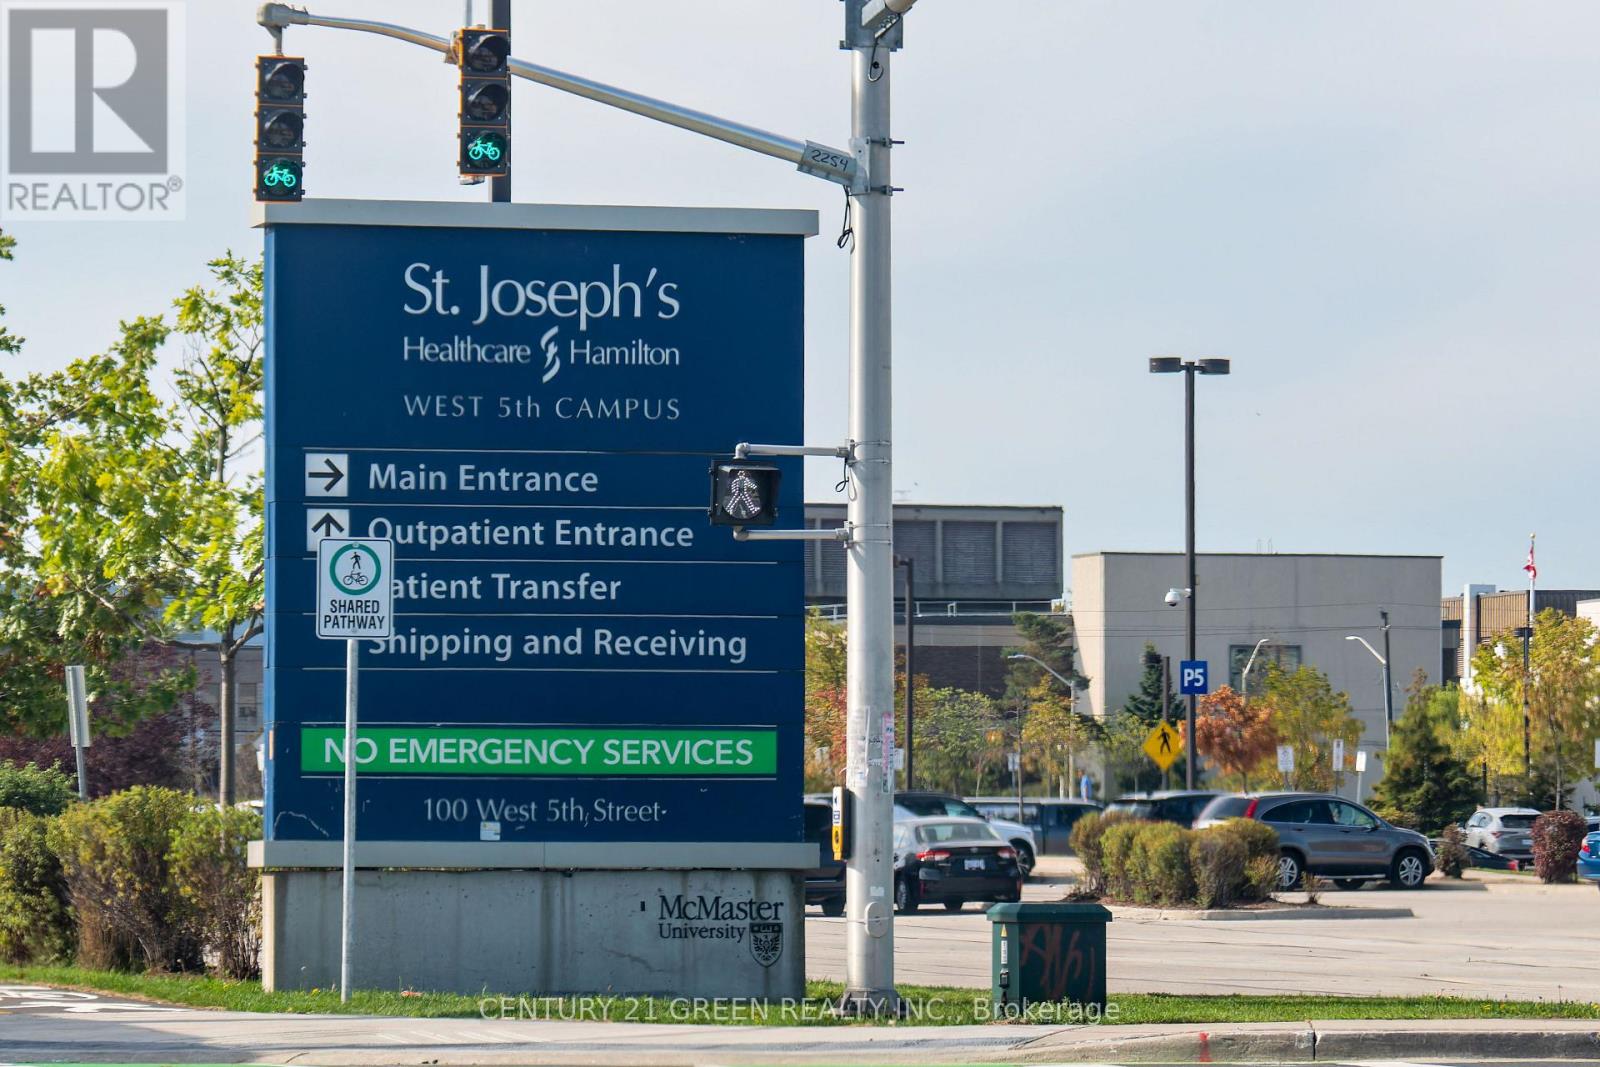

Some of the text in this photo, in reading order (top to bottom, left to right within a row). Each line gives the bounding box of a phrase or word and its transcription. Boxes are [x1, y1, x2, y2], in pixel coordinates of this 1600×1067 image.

[811, 149, 849, 172] 2254
[403, 262, 680, 331] St. Joseph's
[403, 336, 680, 366] Healthcare Hamilton
[404, 395, 680, 420] WEST 5th CAMPUS
[369, 463, 598, 492] Main Entrance
[368, 517, 694, 551] Outpatient Entrance
[393, 572, 622, 600] atient Transfer
[330, 599, 380, 614] SHARED
[323, 614, 385, 629] PATHWAY
[523, 627, 582, 655] and
[594, 628, 746, 664] Receiving
[1183, 668, 1204, 687] P5
[324, 737, 753, 766] NO EMERGENCY SERVICES
[424, 799, 468, 821] 100
[476, 799, 537, 822] West
[593, 799, 661, 822] Street
[659, 895, 784, 921] McMaster
[658, 922, 746, 943] University
